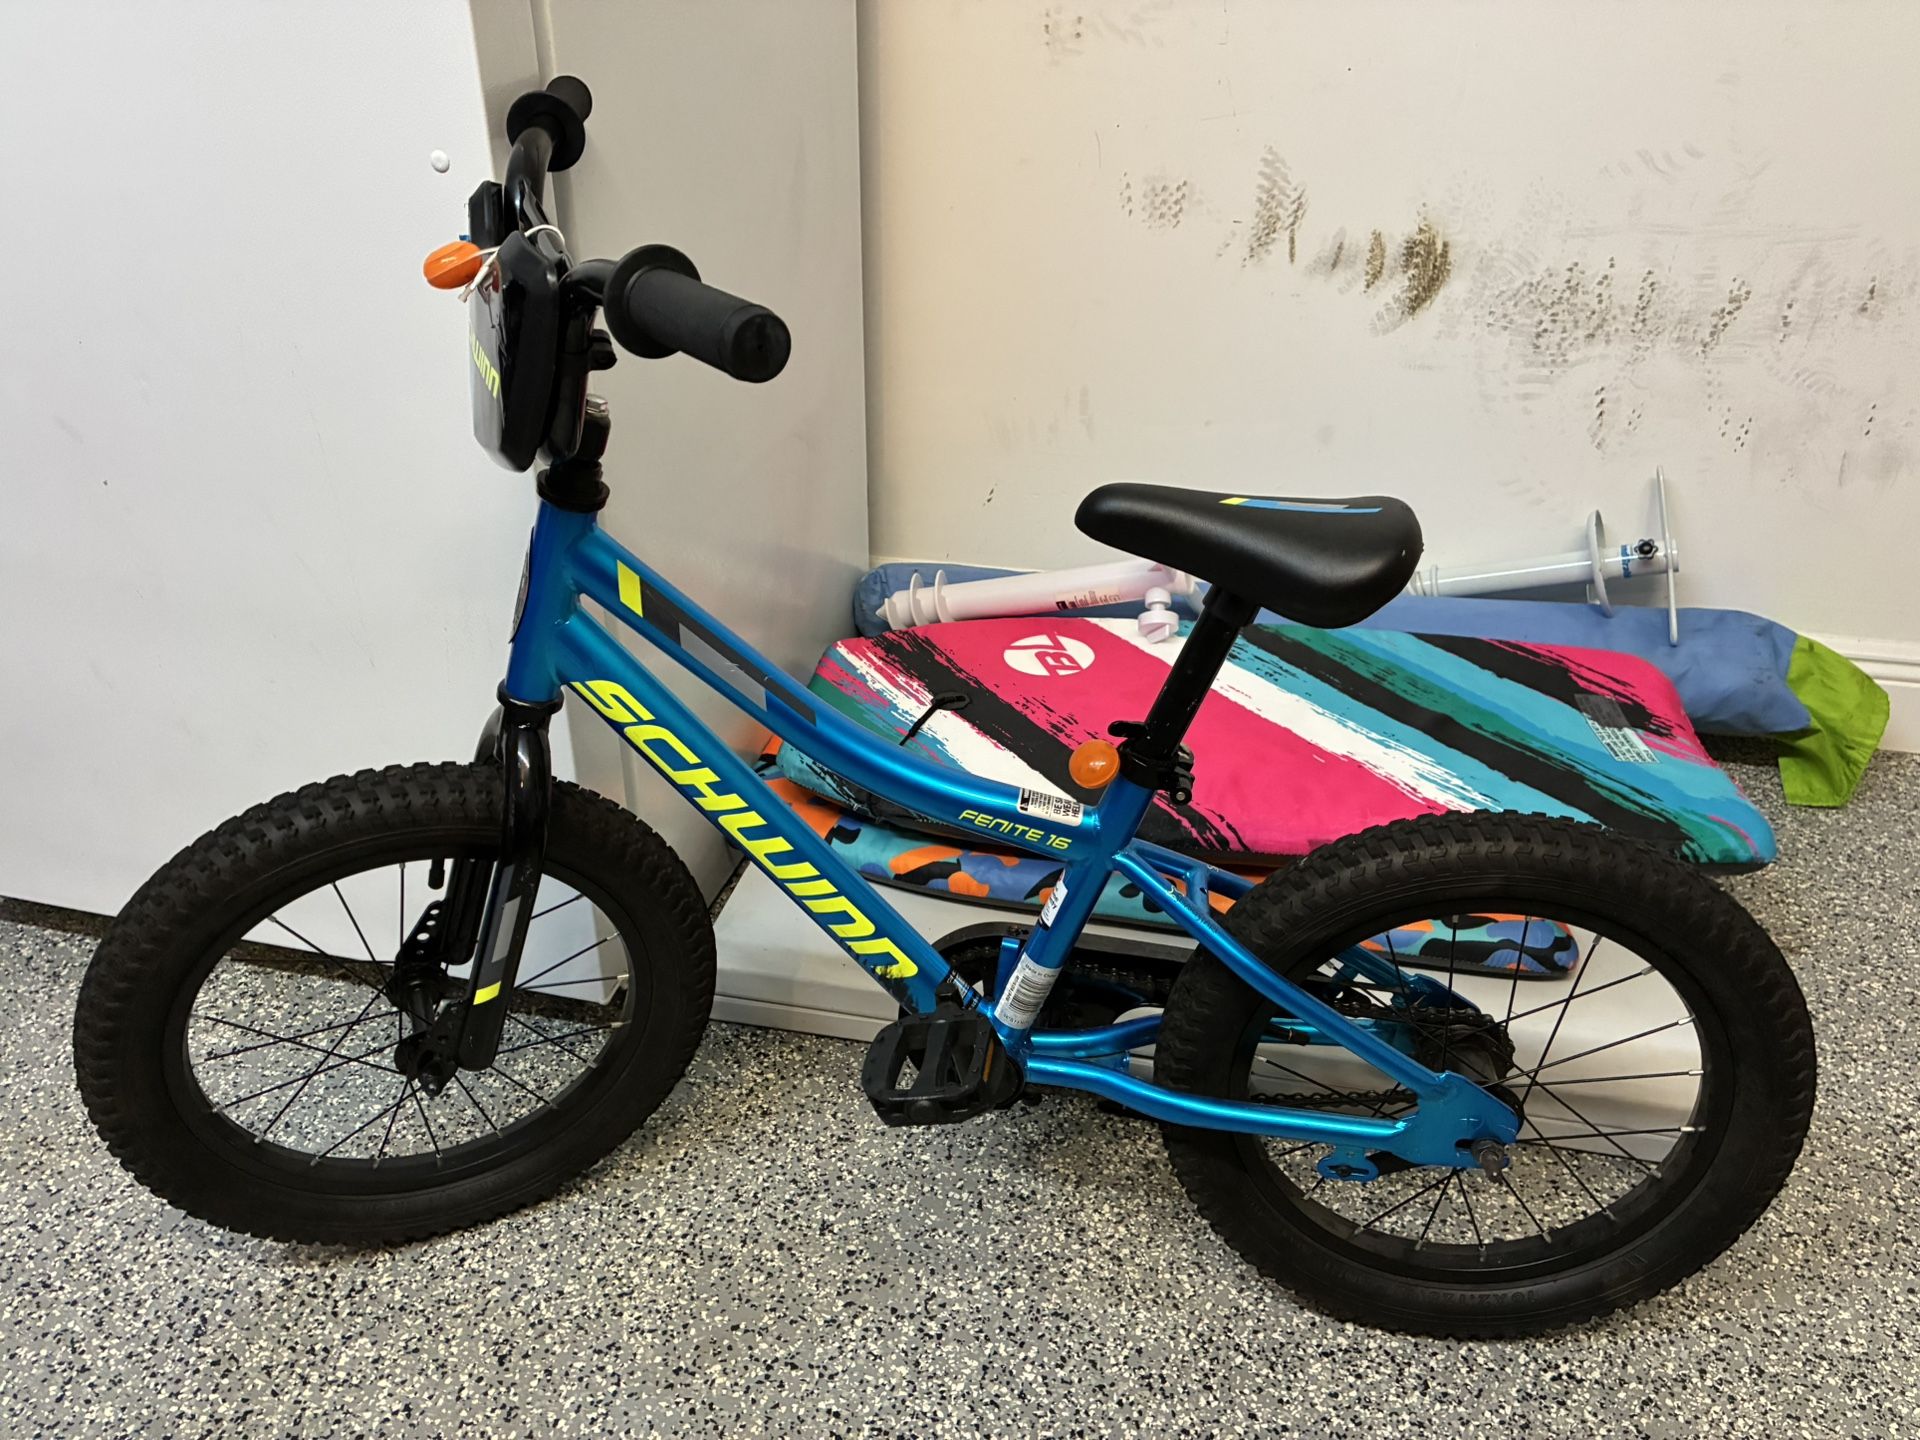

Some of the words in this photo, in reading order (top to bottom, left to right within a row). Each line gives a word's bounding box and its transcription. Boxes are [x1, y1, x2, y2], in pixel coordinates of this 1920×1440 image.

[569, 680, 919, 979] SCHWINN
[958, 809, 1045, 842] FENITE
[1046, 834, 1072, 850] 16
